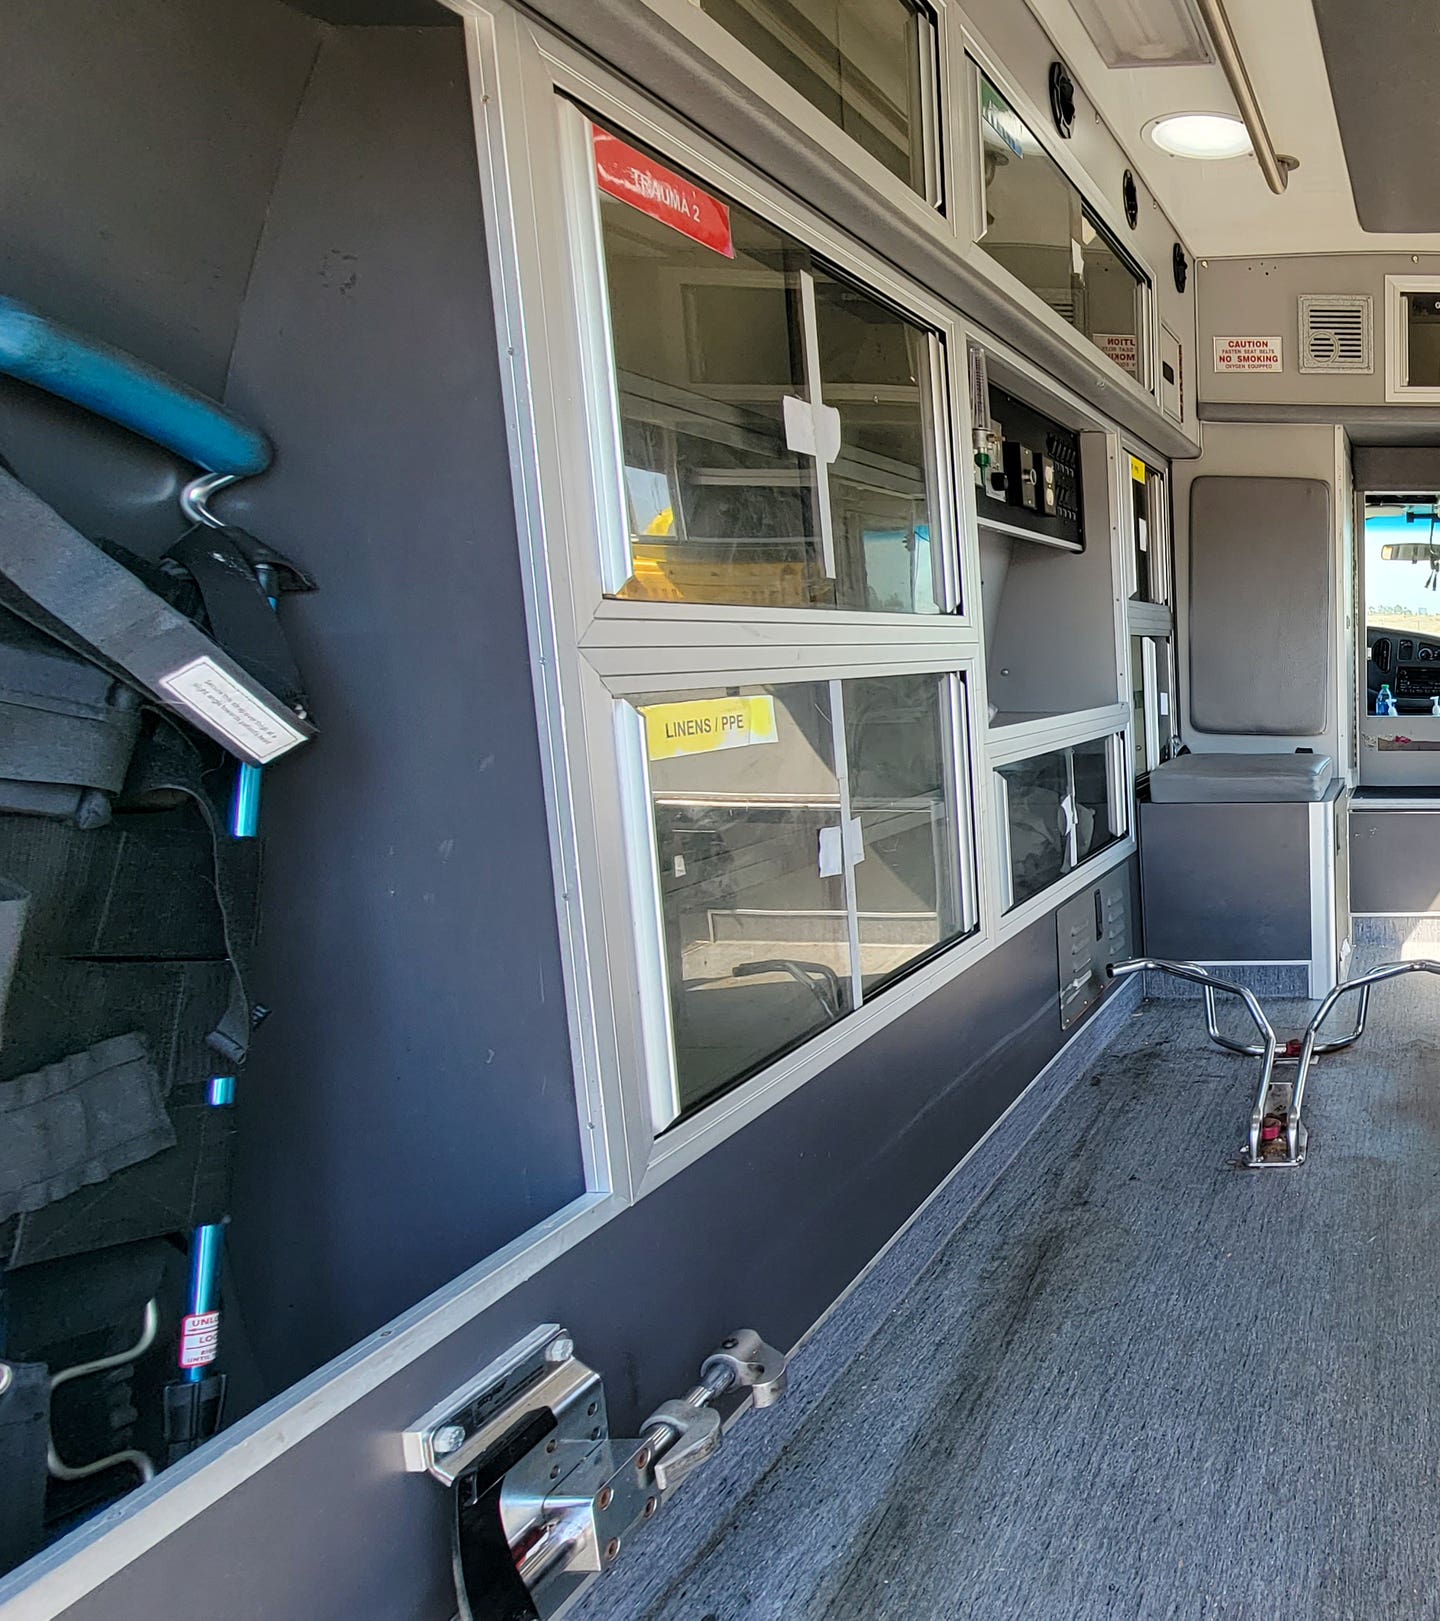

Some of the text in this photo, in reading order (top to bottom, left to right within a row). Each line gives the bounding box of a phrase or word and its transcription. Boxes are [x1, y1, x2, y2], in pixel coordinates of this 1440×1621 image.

[630, 167, 701, 223] TRAUMA 2
[1228, 340, 1269, 348] CAUTION
[1219, 355, 1279, 363] NO SMOKING
[665, 718, 712, 738] LINENS
[721, 714, 744, 730] PPE
